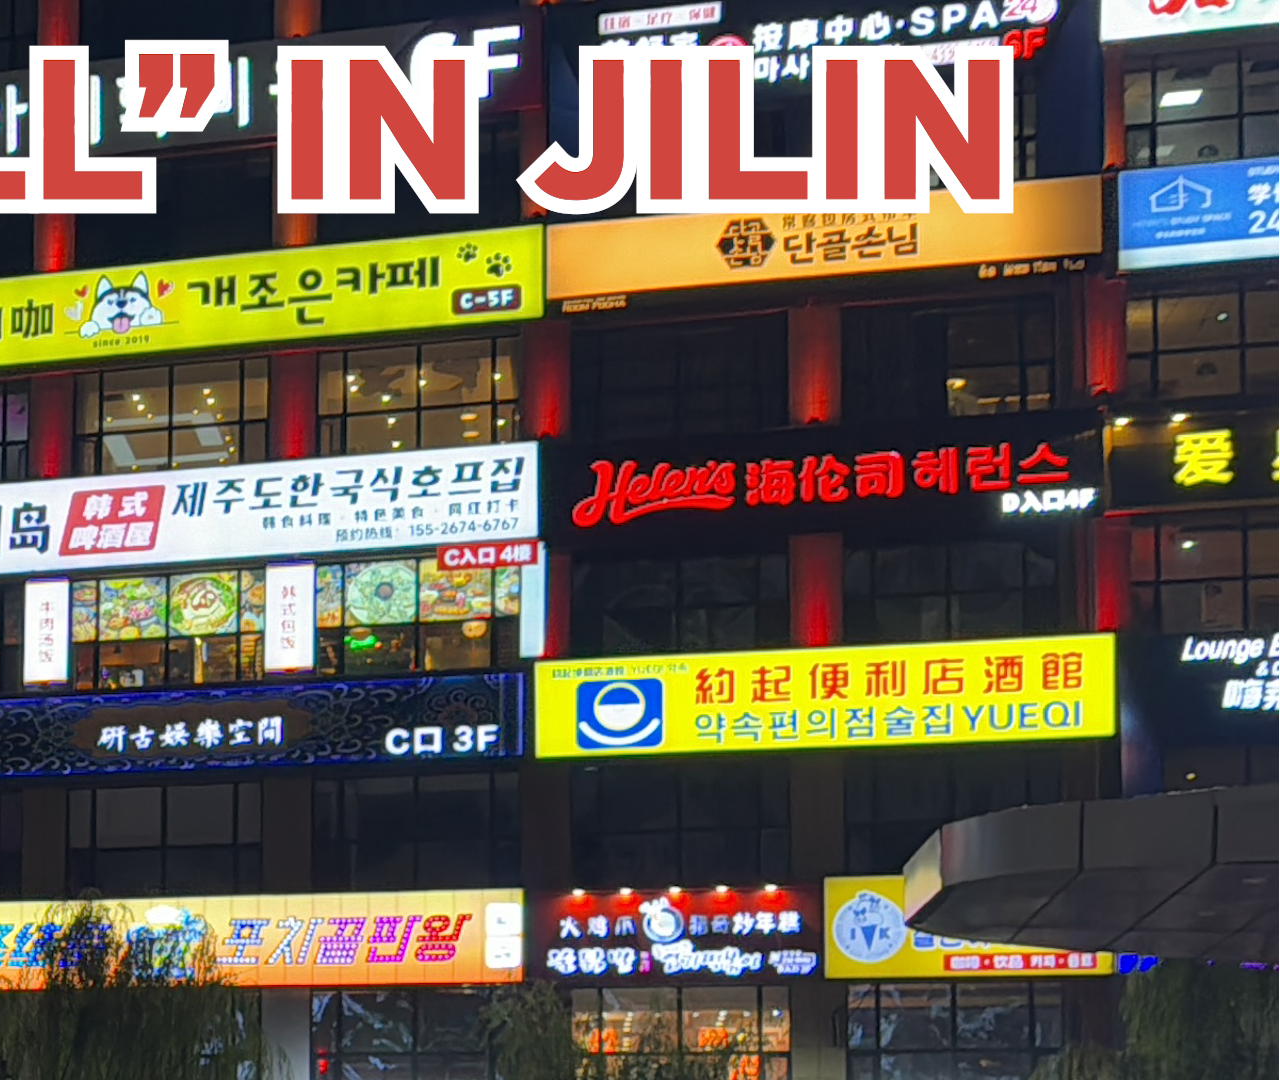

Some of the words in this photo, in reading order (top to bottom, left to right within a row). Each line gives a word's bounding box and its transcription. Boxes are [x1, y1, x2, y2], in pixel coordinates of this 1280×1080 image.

[783, 221, 919, 265] 단골손님
[186, 255, 441, 326] 개조은카페
[82, 493, 149, 520] 韩式
[170, 455, 525, 518] 제주도한국식호프집
[571, 459, 738, 528] Helen's
[744, 450, 904, 508] 海伦司
[912, 441, 1073, 492] 헤런스
[409, 517, 520, 538] 155-2674-6767
[443, 546, 497, 566] C入口
[1180, 635, 1265, 665] Lounge
[693, 650, 1084, 707] 約起便利店酒館
[452, 723, 501, 754] 3F
[693, 703, 955, 745] 약속편의점술집
[966, 699, 1084, 733] YUEQI
